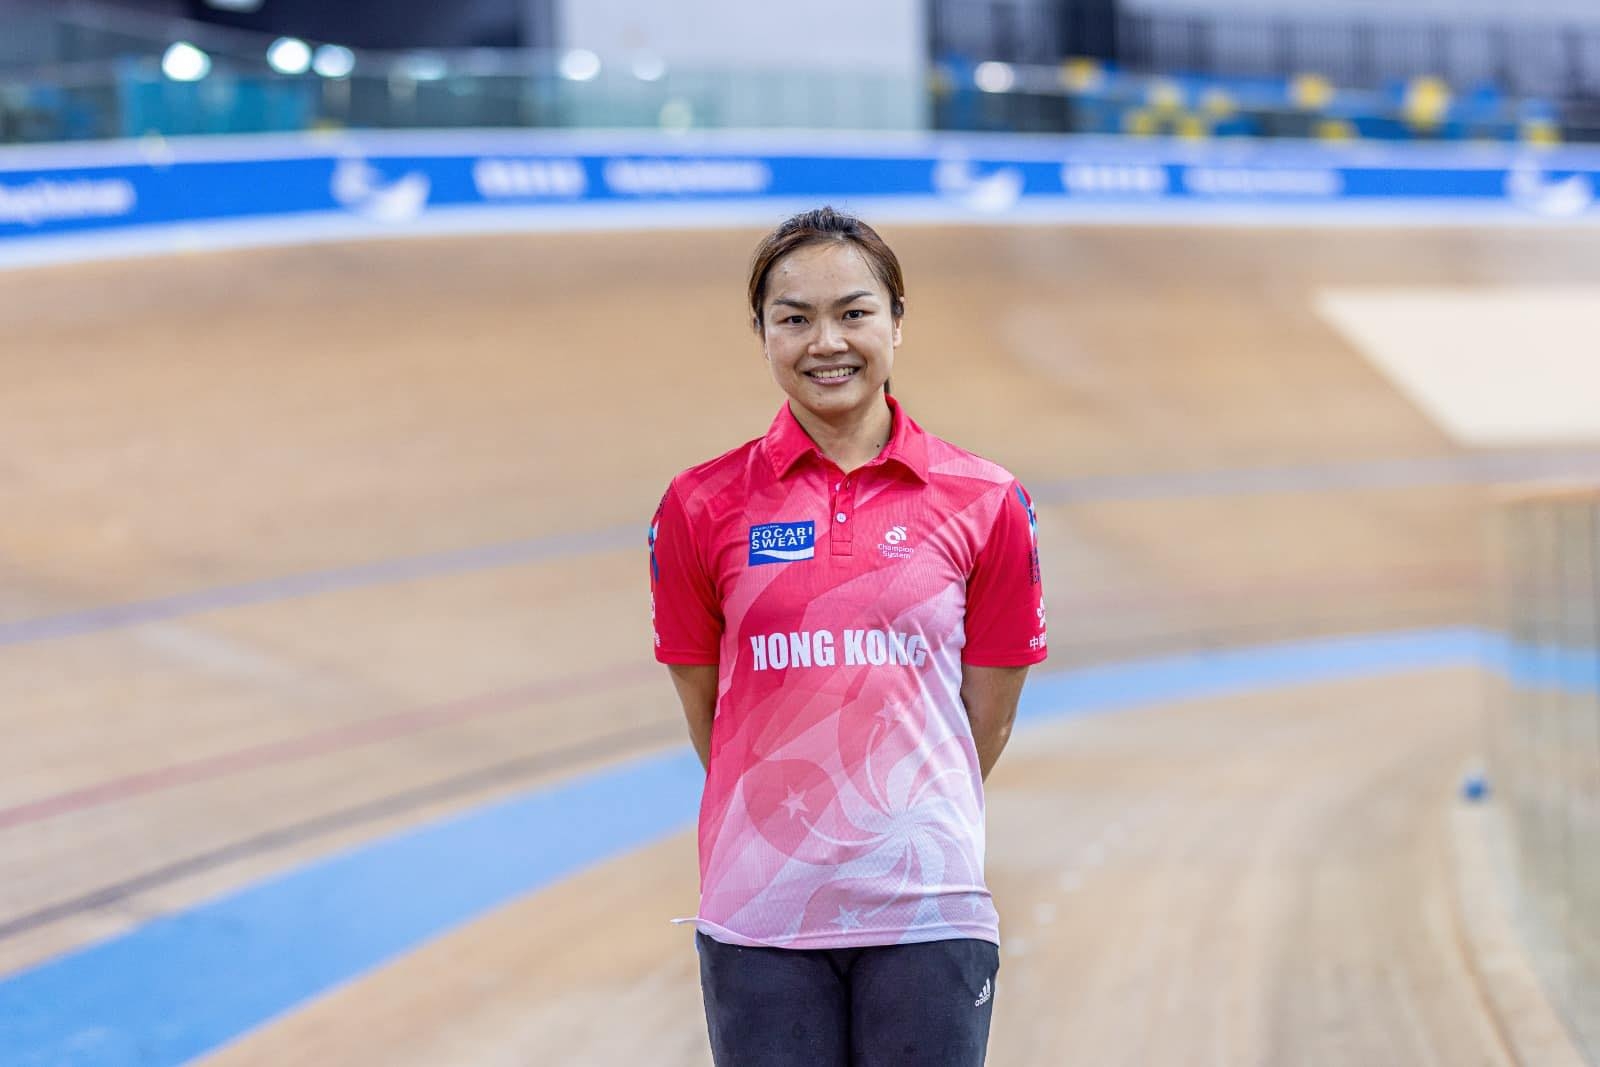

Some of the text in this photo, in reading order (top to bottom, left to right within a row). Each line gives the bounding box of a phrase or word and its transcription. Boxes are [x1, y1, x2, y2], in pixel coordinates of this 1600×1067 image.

[751, 526, 813, 540] POCARI
[751, 535, 807, 550] SWEAT
[878, 543, 914, 553] Champion
[882, 550, 911, 559] System
[750, 629, 928, 671] HONG KONG
